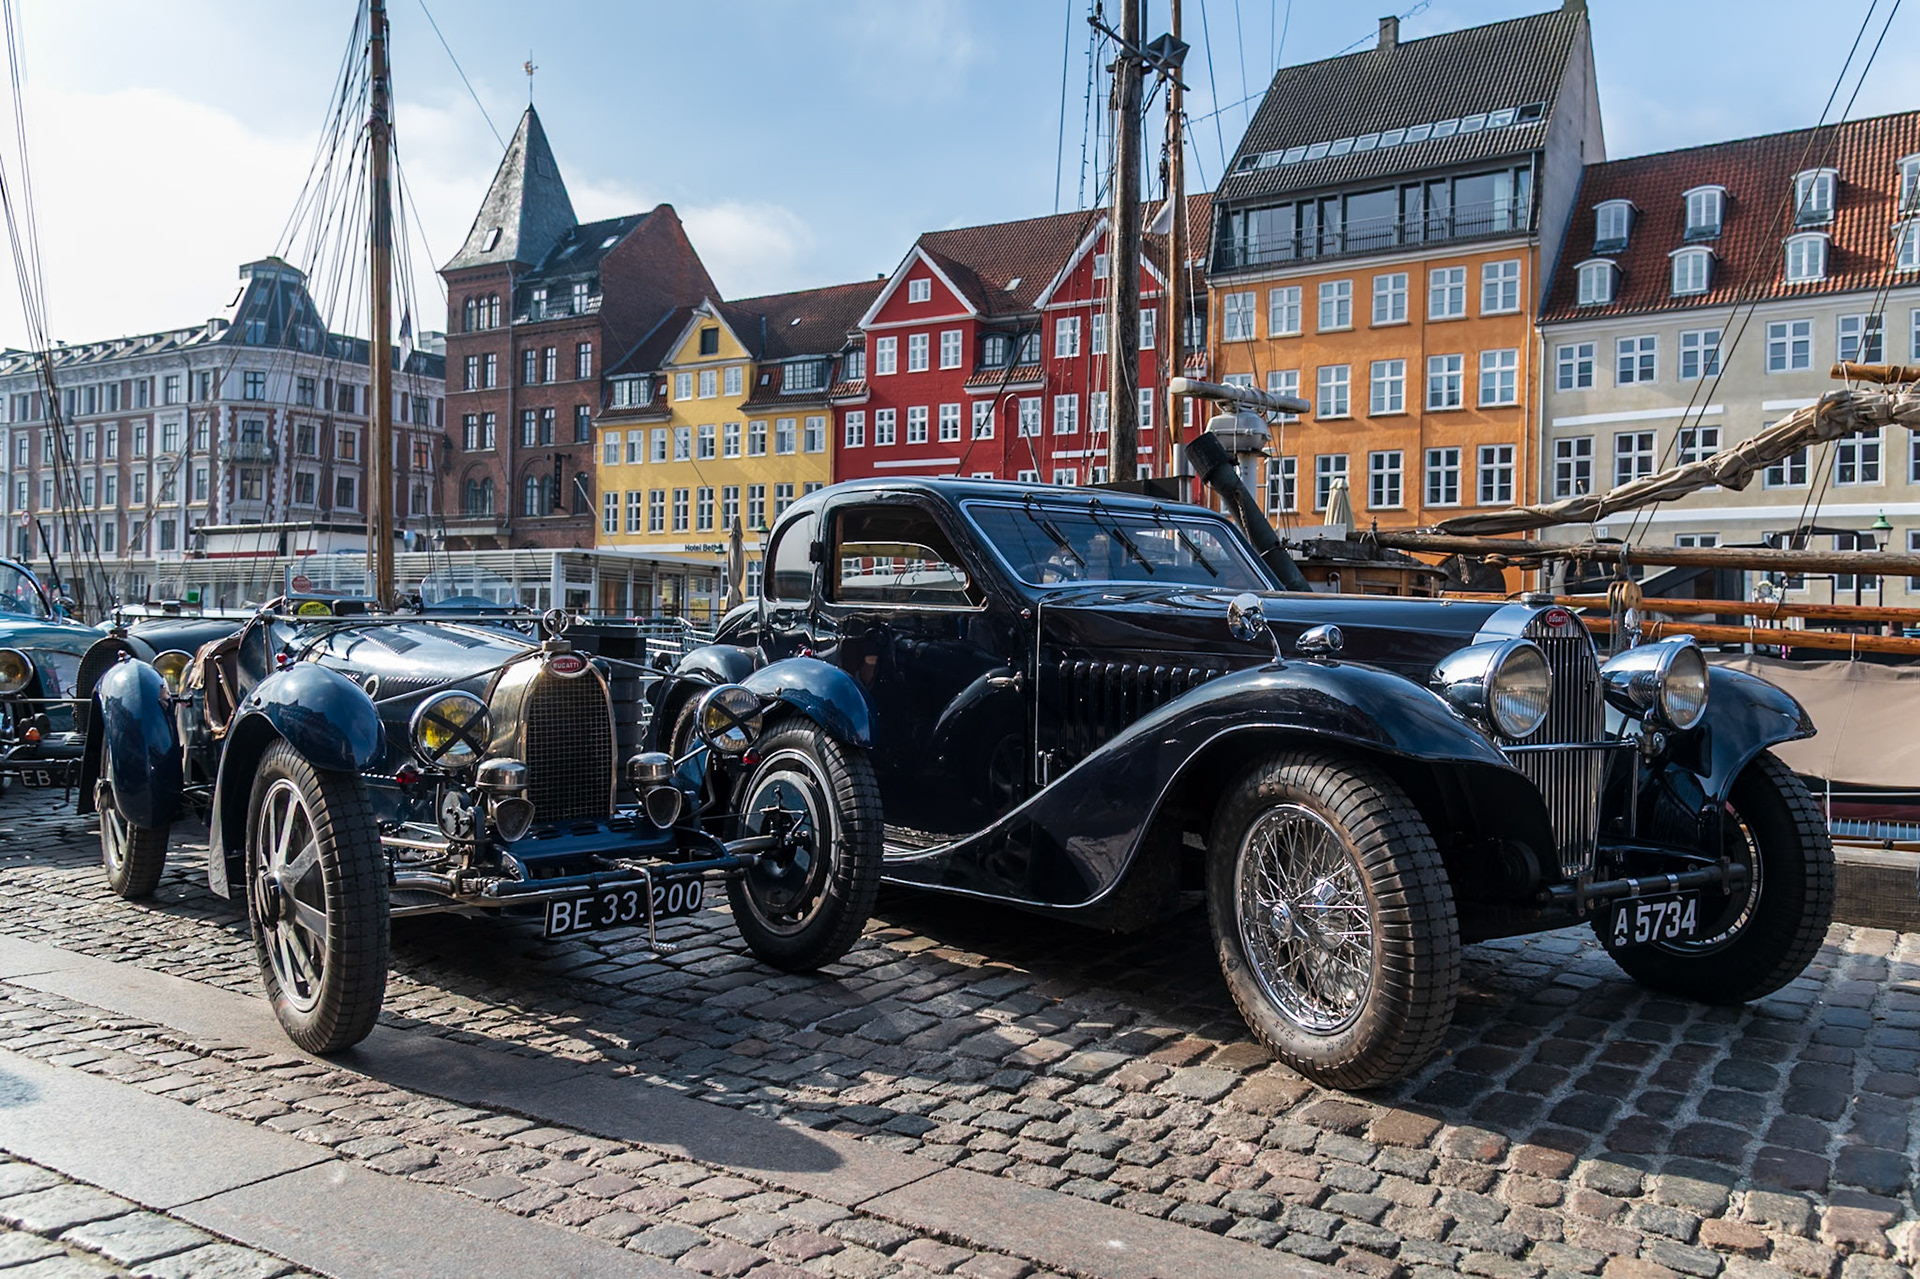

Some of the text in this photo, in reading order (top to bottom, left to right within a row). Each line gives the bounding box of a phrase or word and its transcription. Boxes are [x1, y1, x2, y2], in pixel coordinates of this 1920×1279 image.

[684, 544, 702, 552] Hotel
[20, 769, 51, 786] EB
[551, 880, 702, 934] BE 33.200
[1614, 898, 1697, 943] A 5734
